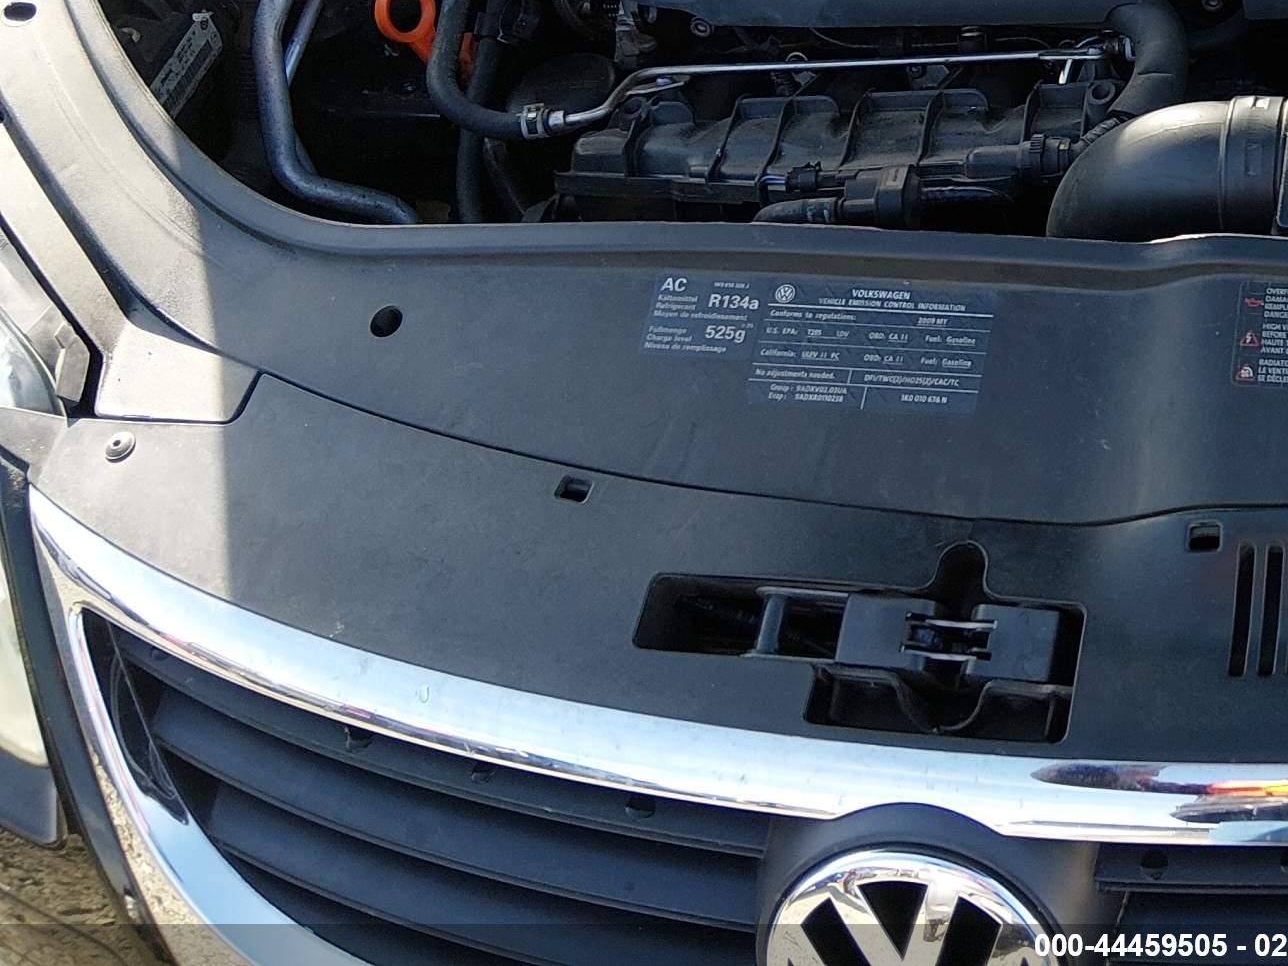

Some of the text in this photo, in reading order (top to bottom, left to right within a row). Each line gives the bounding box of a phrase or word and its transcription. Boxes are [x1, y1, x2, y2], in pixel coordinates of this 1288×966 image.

[661, 277, 687, 292] AC
[852, 289, 911, 300] VOLKSWAGEN
[708, 293, 759, 310] R134a
[848, 299, 881, 307] EMISSION
[883, 301, 915, 309] CONTROL
[917, 303, 966, 311] INFORMATION
[770, 309, 802, 317] Conforms
[815, 312, 856, 321] regulations:
[1262, 323, 1281, 331] HIGH
[705, 325, 746, 343] 525g
[1262, 331, 1287, 339] BEFORE
[946, 335, 976, 345] Gasoline
[1261, 338, 1284, 346] HAUTE
[1260, 347, 1285, 355] AVANT
[942, 358, 972, 367] Gasoline
[766, 369, 808, 378] adjustments
[1258, 374, 1266, 382] SE
